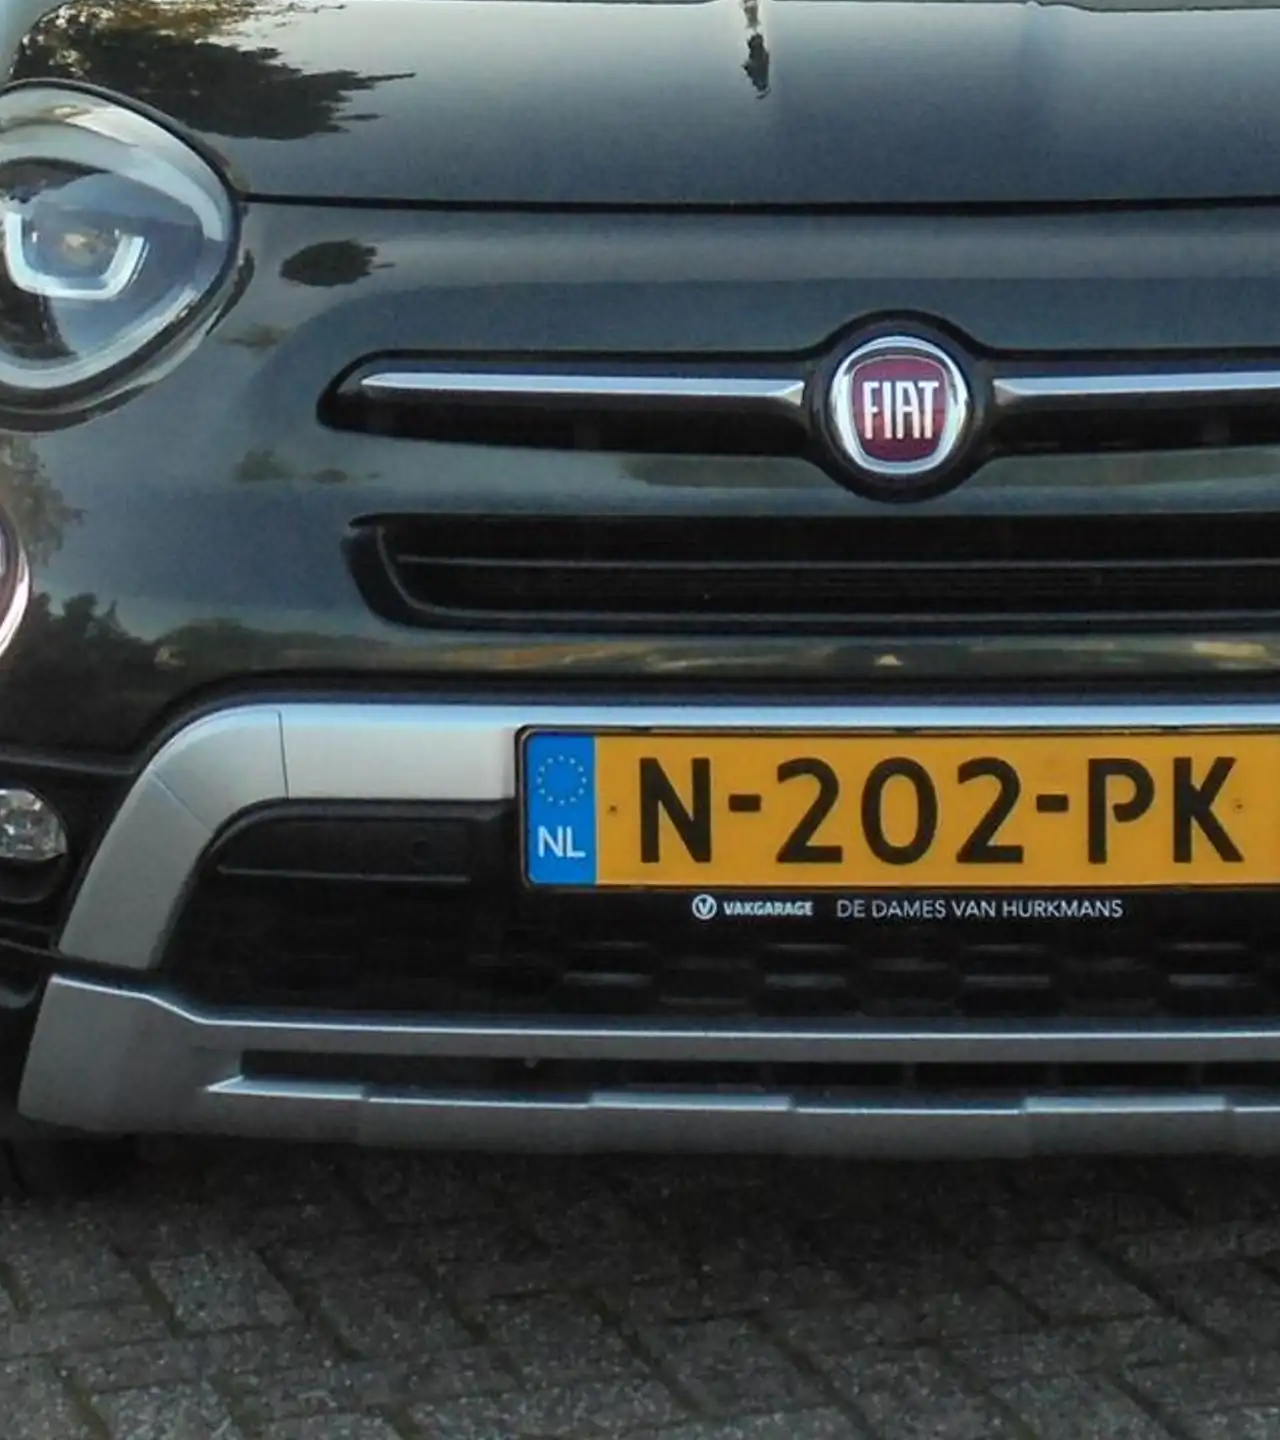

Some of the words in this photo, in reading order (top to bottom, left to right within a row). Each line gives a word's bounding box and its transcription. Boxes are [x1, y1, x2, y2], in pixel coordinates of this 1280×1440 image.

[862, 380, 940, 440] FIAT
[639, 756, 1245, 866] N-202-PK
[537, 825, 587, 858] NL
[723, 900, 814, 917] VAKGARAGE
[836, 900, 866, 918] DE
[871, 900, 946, 918] DAMES
[951, 900, 996, 918] VAN
[1002, 899, 1124, 918] HURKMANS
